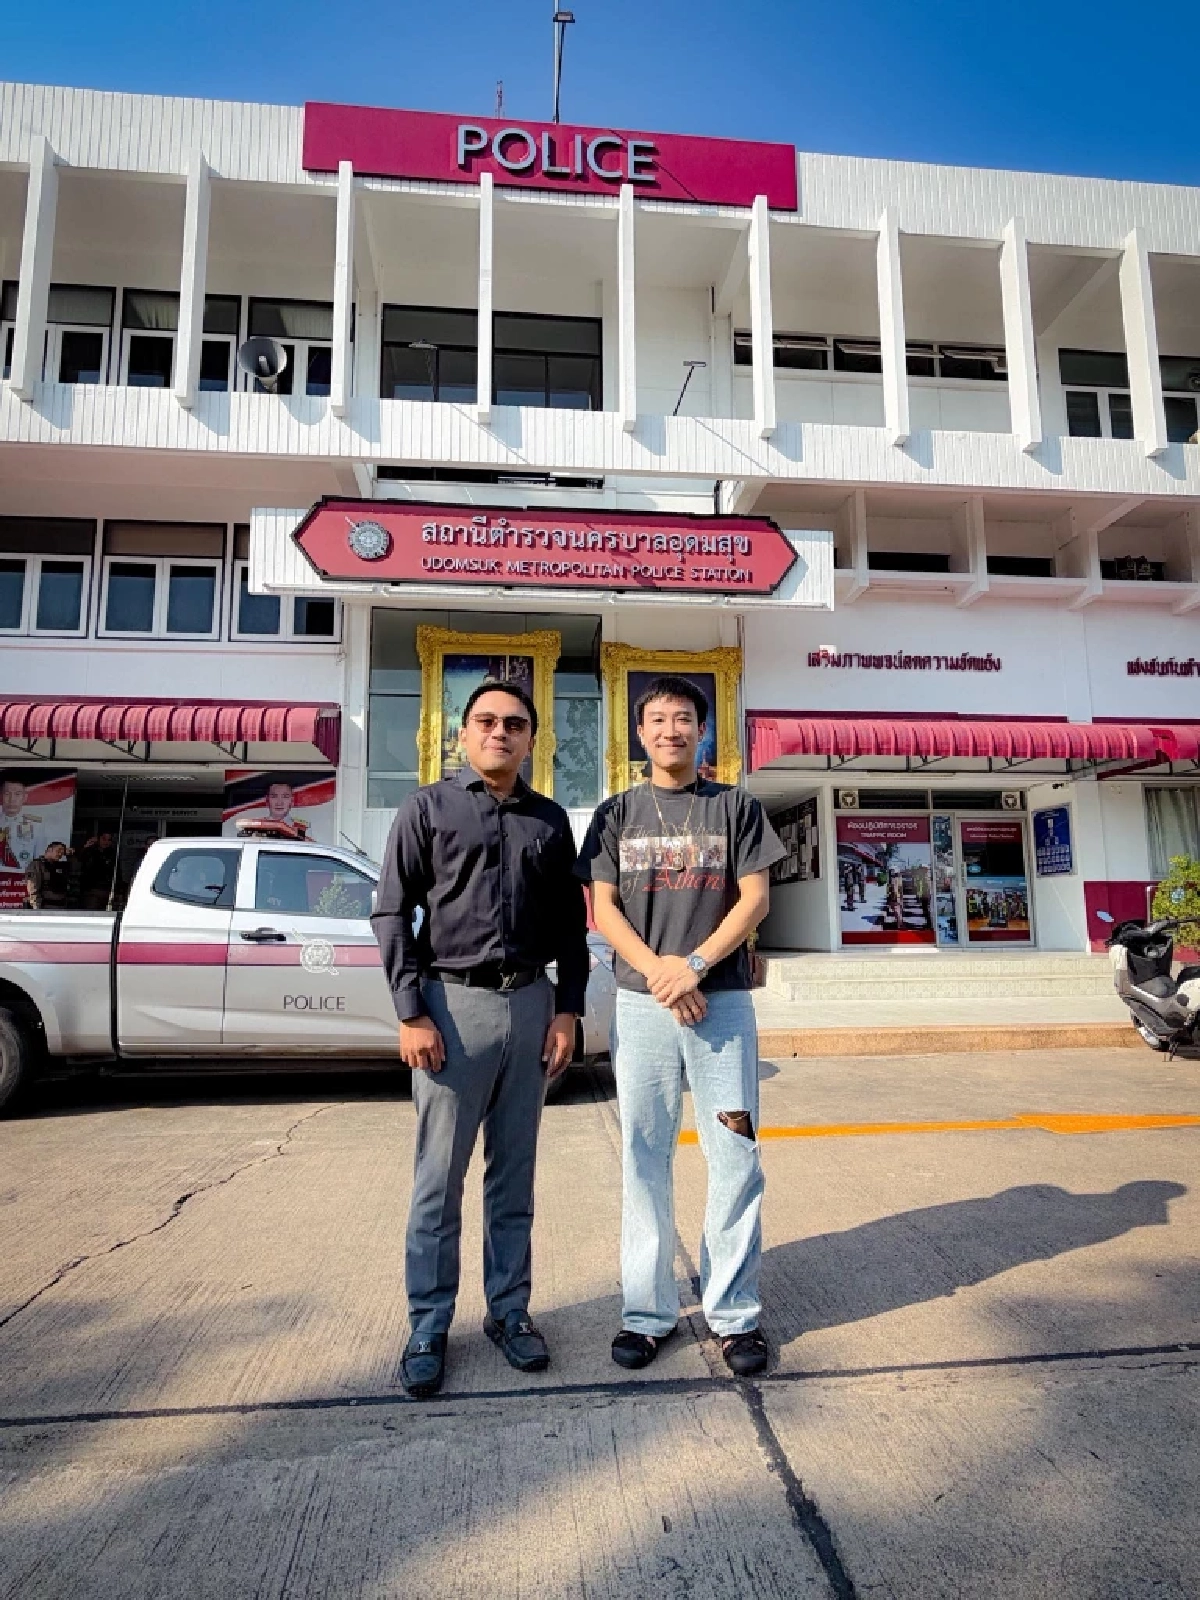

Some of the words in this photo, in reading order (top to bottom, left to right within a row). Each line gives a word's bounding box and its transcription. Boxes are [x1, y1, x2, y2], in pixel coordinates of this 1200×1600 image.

[457, 124, 656, 182] POLICE
[421, 515, 750, 562] สถานีตำรวจนครบาลอุดมสุข
[421, 556, 500, 572] UDOMSUK
[506, 560, 624, 577] METROPOLITAN
[631, 564, 685, 579] POLICE
[691, 567, 752, 581] STATION
[283, 994, 346, 1012] POLICE
